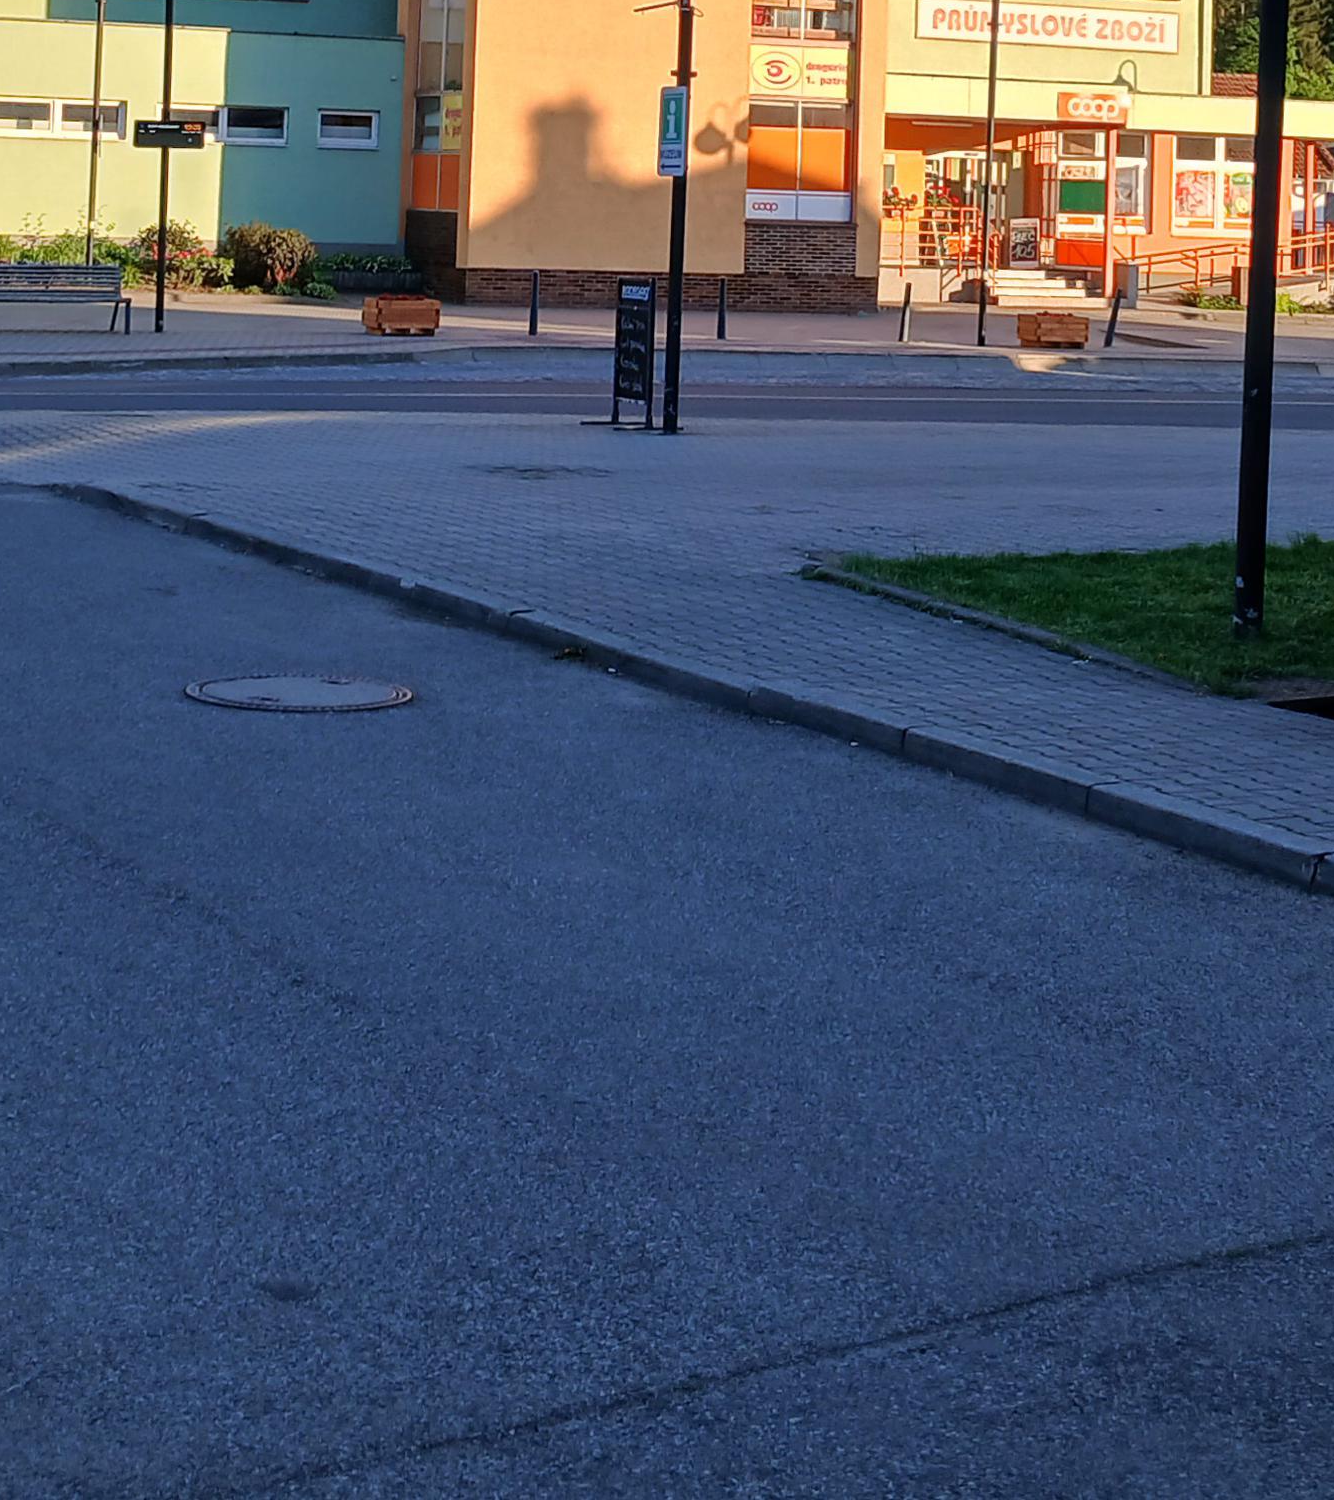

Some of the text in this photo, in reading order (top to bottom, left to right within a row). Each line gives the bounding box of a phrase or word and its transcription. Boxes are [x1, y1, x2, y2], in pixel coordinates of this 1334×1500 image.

[1094, 16, 1166, 44] ZBOŽÍ
[1067, 97, 1120, 120] coop
[752, 202, 779, 213] coop
